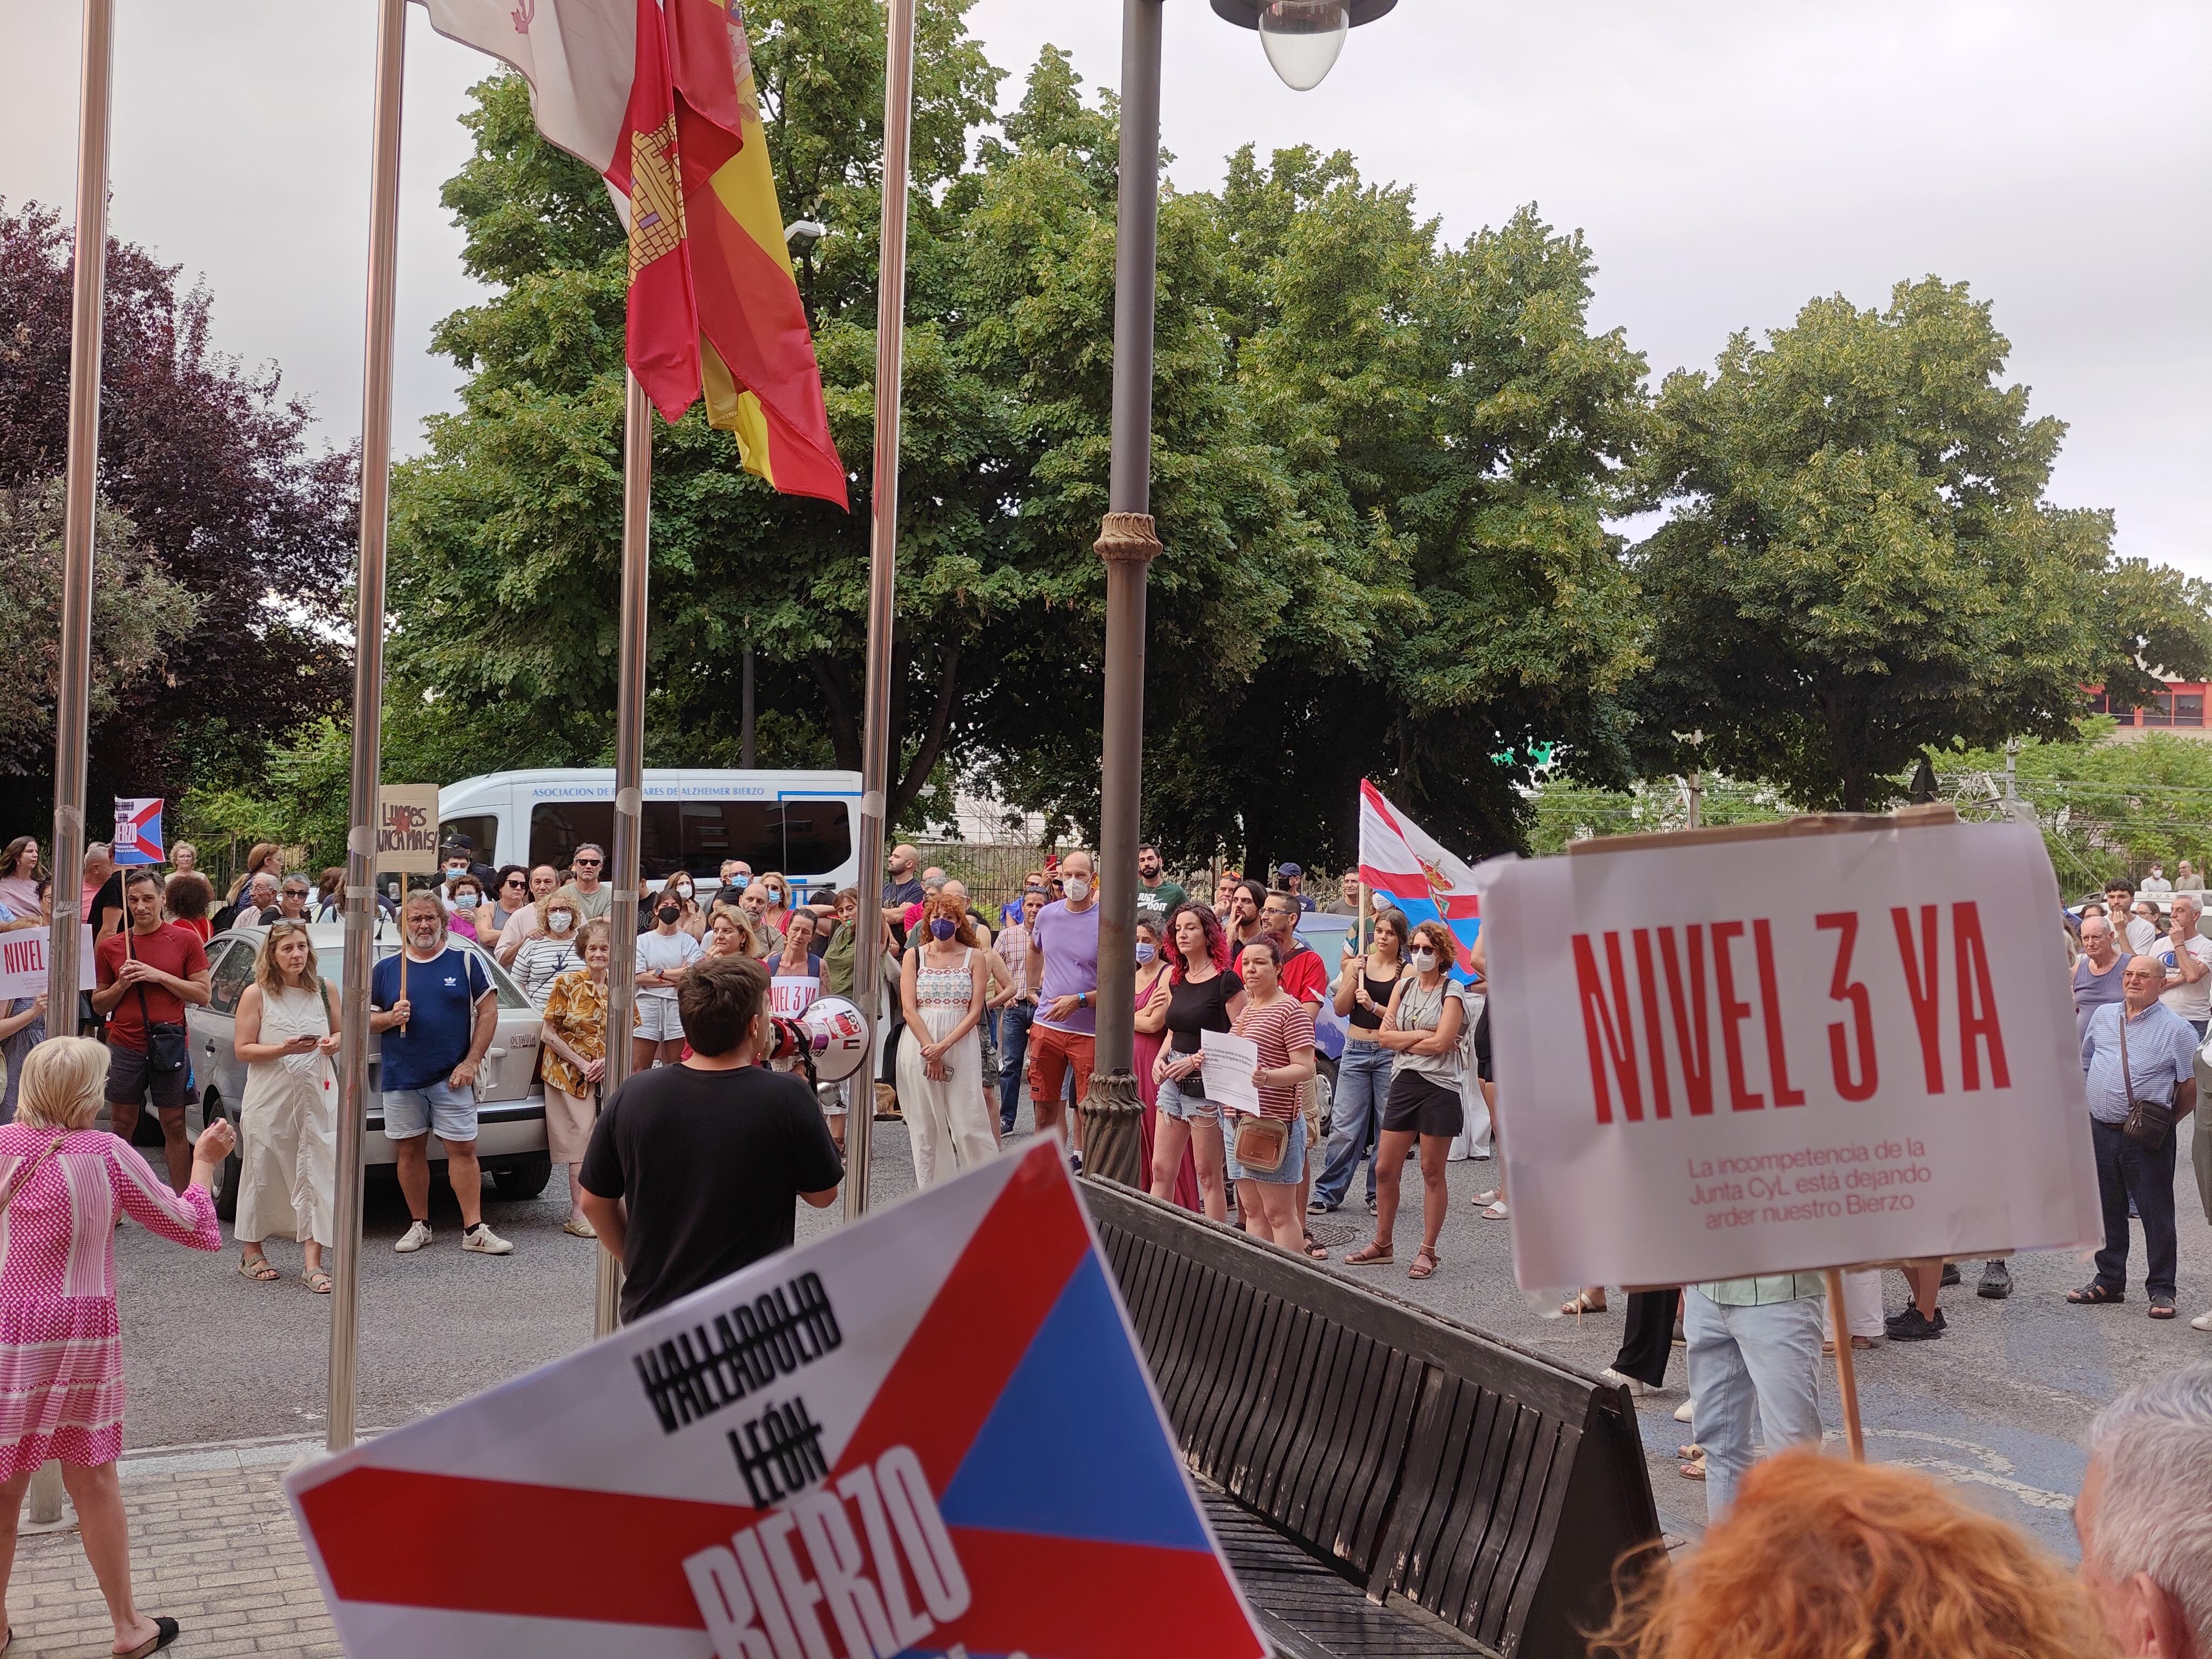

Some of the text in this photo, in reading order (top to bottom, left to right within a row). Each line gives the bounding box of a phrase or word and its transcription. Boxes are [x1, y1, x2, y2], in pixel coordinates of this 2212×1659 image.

[682, 787, 730, 795] ALZHEIMER
[733, 787, 764, 795] BIERZO
[115, 823, 137, 843] IERZO
[376, 830, 405, 853] UNCA
[1137, 893, 1156, 902] JUST
[4, 940, 45, 974] NIVEL
[771, 986, 790, 1013] IVEL
[793, 986, 801, 1011] 3
[1570, 900, 2011, 1125] NIVEL 3 YA
[510, 1034, 536, 1045] OCTAVIA
[1687, 1136, 1926, 1178] La incompetencia de la
[1689, 1162, 1932, 1205] Junta CyL está dejando
[1705, 1193, 1915, 1230] arder nuestro Bierzo
[633, 1272, 842, 1435] VALLADOLID
[682, 1445, 971, 1659] BIERZO
